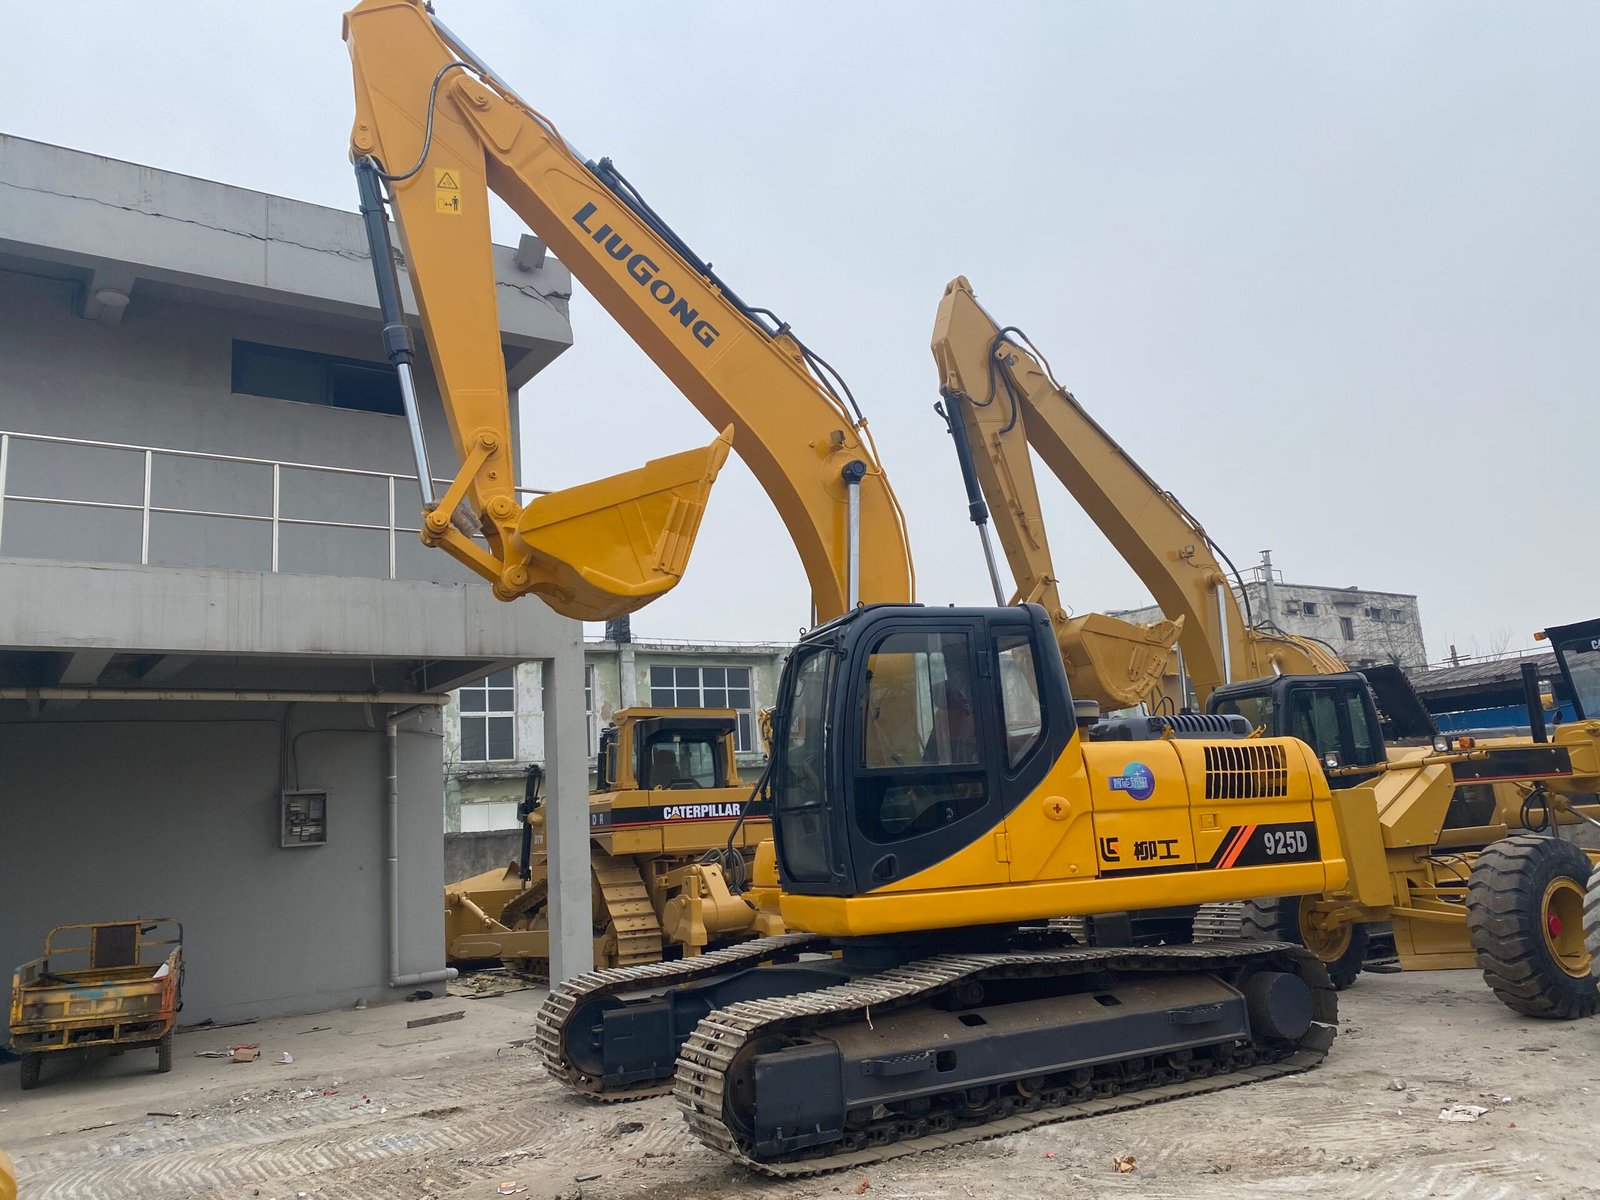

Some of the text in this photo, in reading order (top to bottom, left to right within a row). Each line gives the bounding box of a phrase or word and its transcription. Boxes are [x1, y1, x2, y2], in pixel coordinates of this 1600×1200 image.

[571, 201, 721, 348] LIUGONG
[663, 803, 741, 820] CATERPILLAR
[1133, 838, 1180, 861] 柳工
[1263, 830, 1308, 856] 925D
